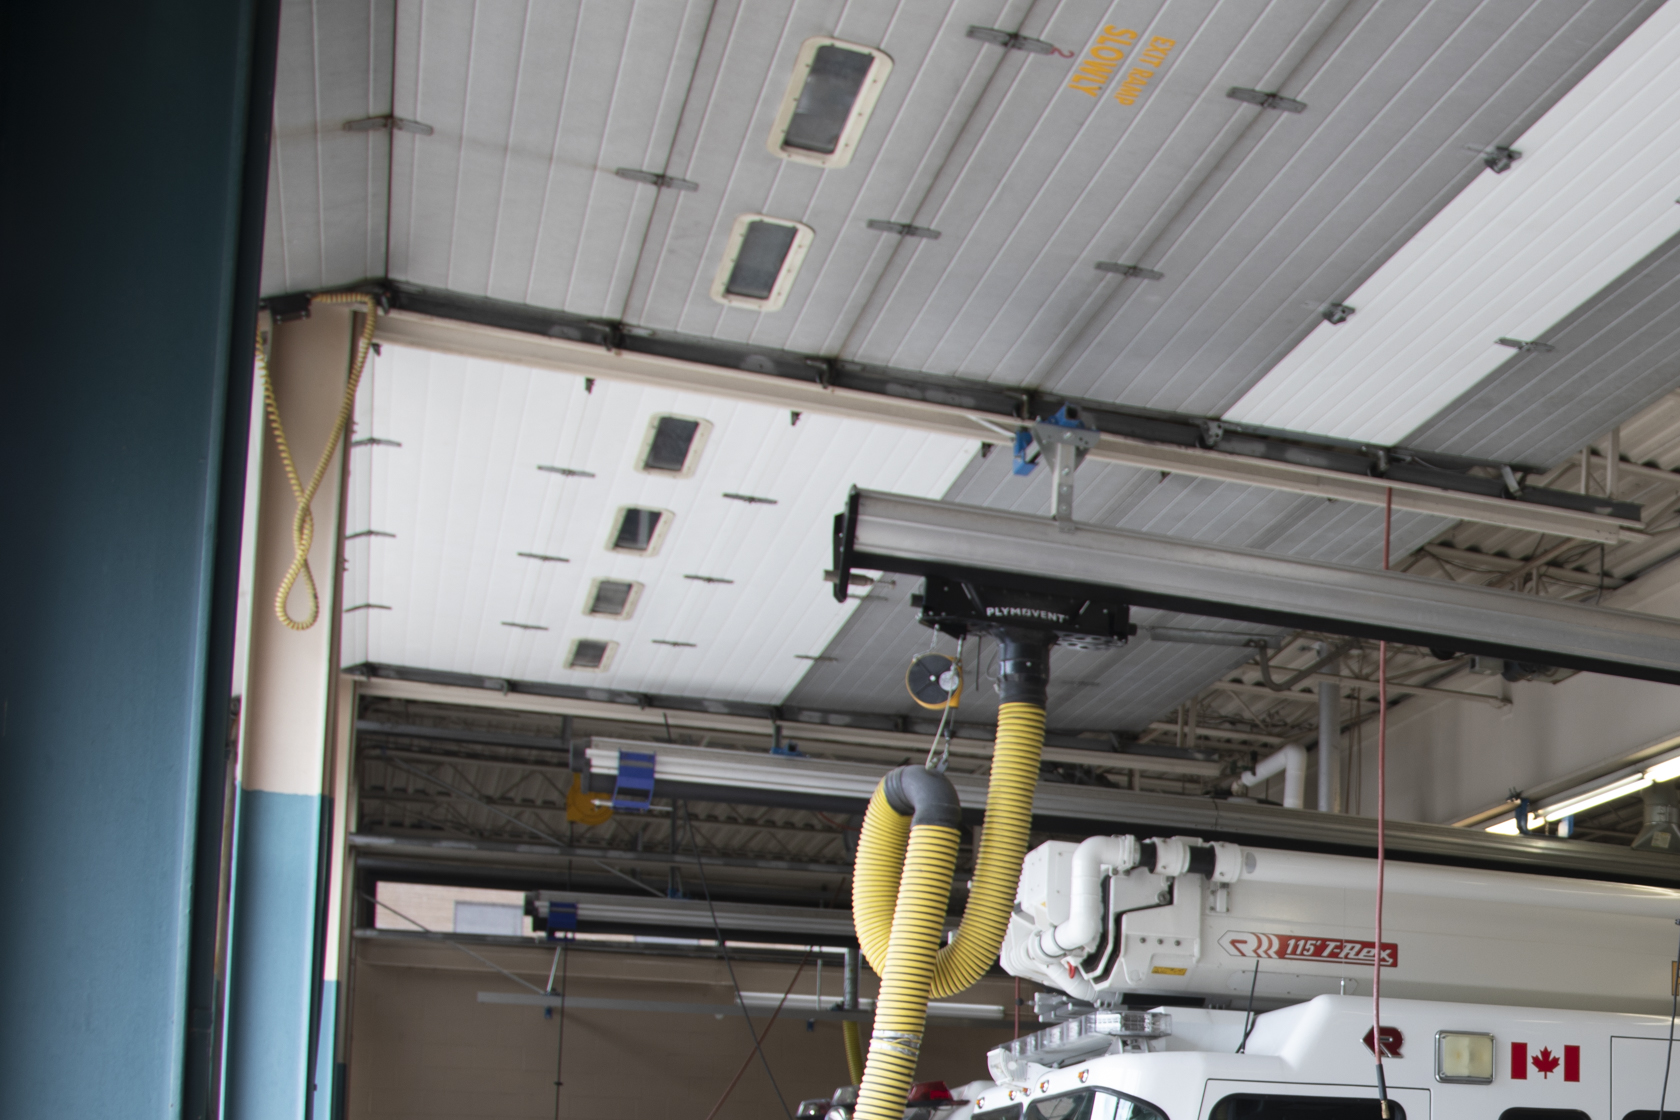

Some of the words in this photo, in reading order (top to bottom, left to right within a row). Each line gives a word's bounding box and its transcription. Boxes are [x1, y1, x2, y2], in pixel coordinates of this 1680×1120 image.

[1067, 24, 1138, 98] SLOWLY
[1139, 35, 1176, 68] EXIT
[1113, 67, 1155, 106] RAMP
[986, 606, 1067, 623] PLYMOVENT
